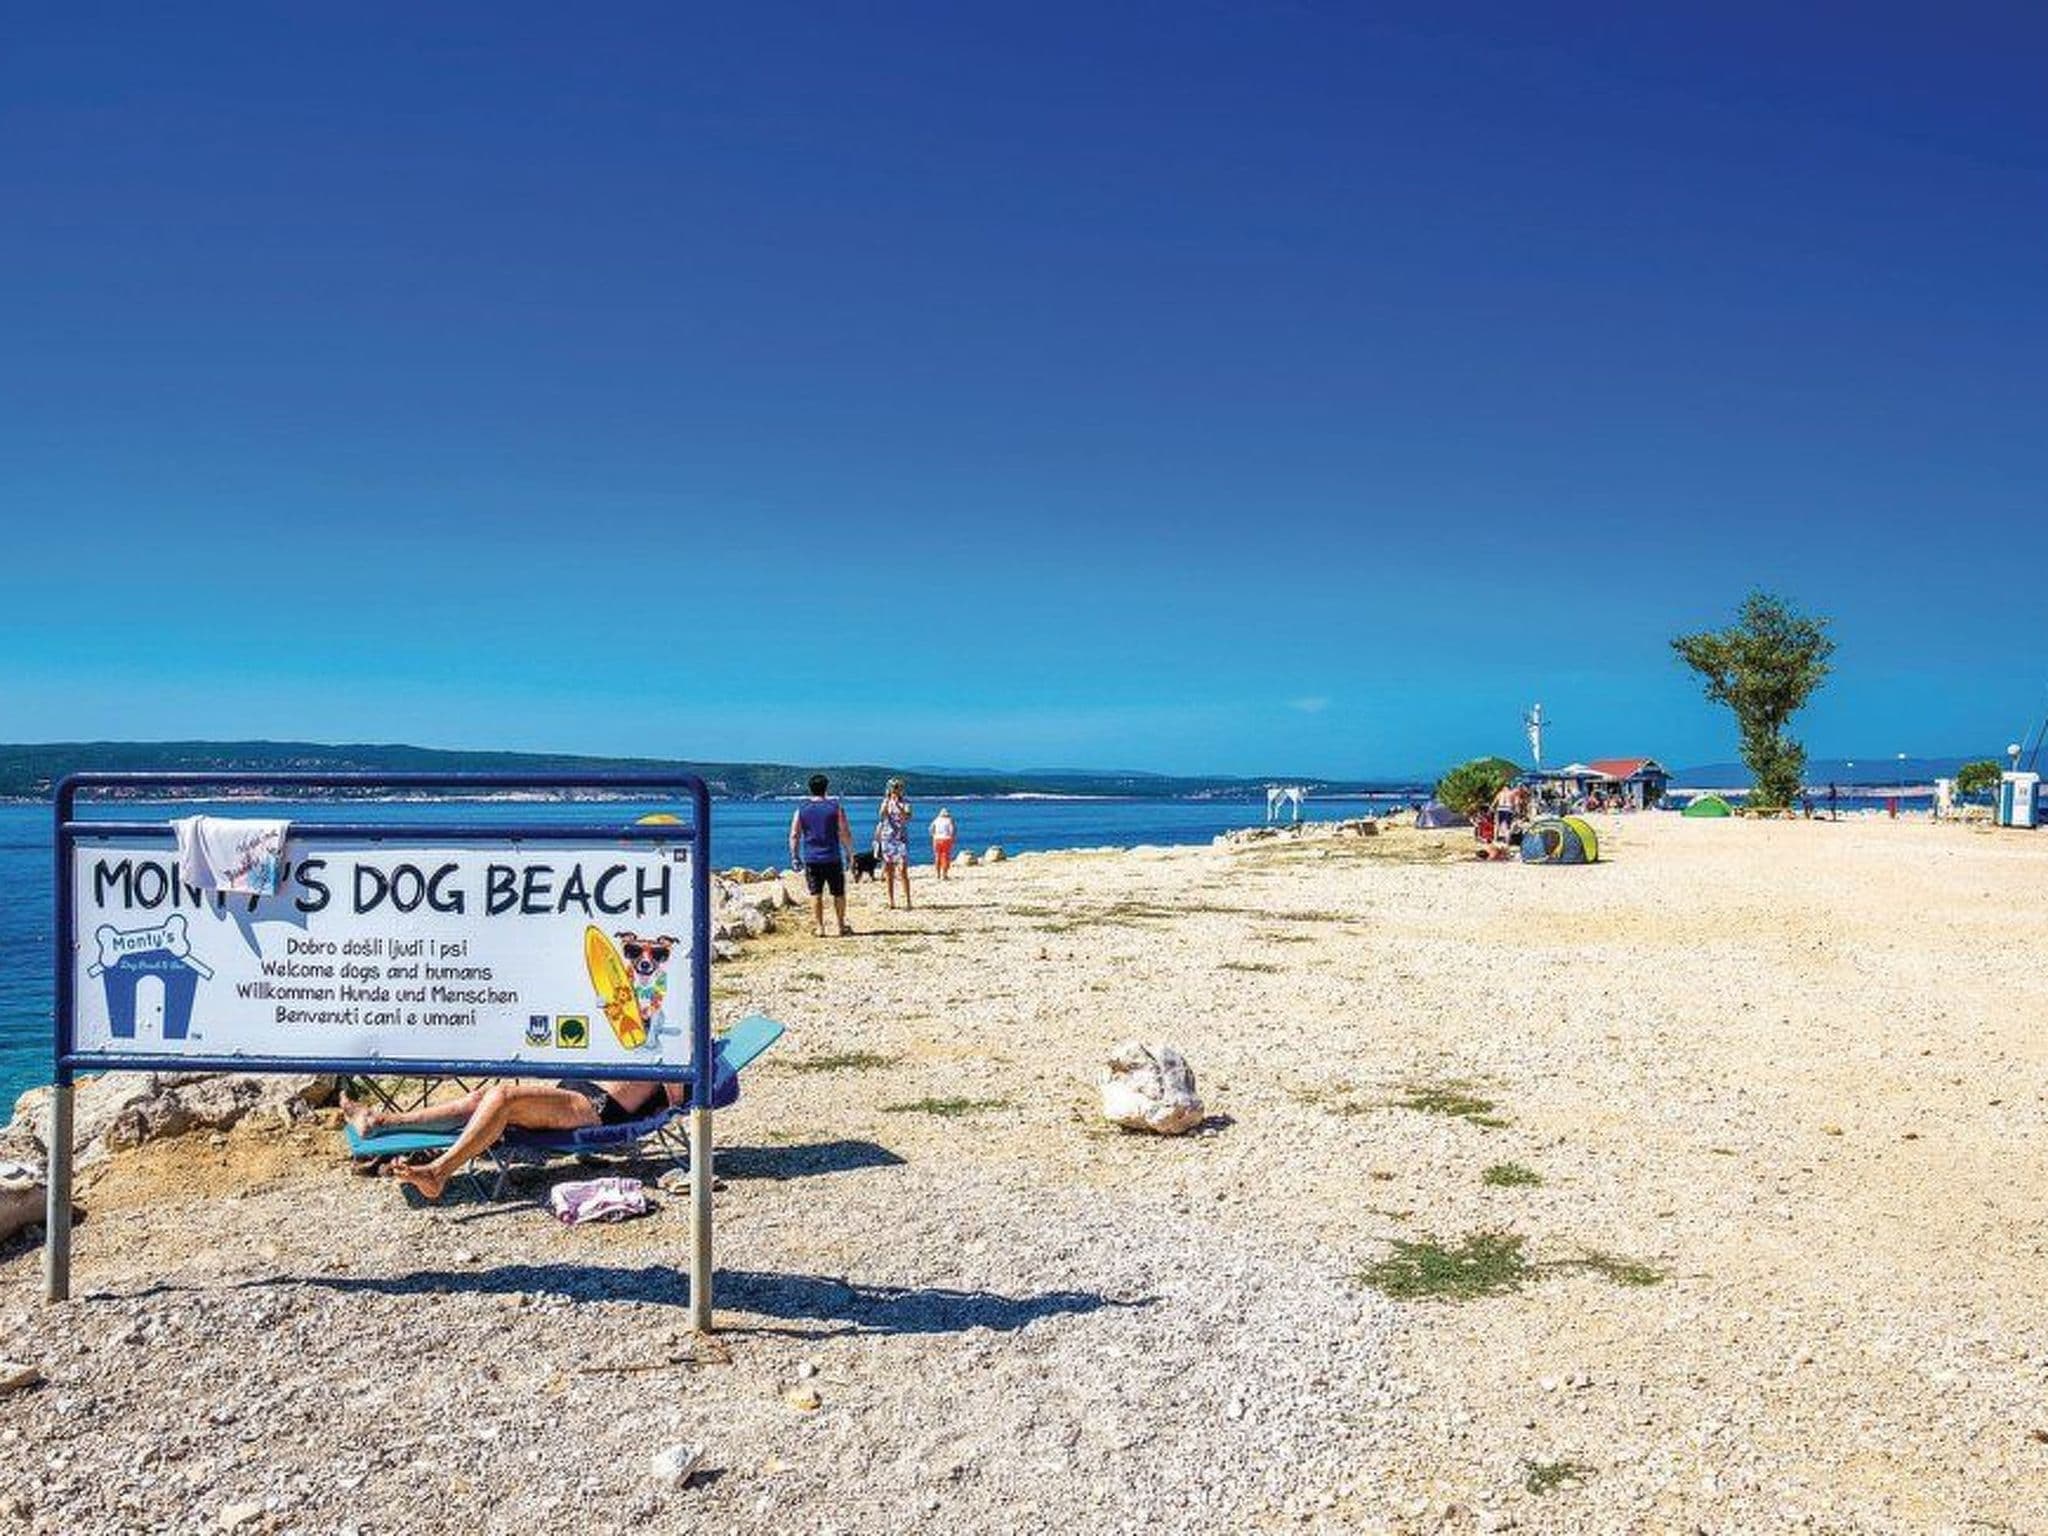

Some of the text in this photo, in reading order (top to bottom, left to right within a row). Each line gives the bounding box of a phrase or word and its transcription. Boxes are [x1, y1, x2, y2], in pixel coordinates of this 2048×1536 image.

[94, 857, 330, 912] MON'S
[354, 863, 465, 915] DOG
[485, 862, 672, 917] BEACH
[112, 931, 175, 950] Monty's
[287, 938, 337, 955] Dobro
[342, 938, 383, 956] došli
[388, 939, 423, 960] ljudi
[440, 940, 468, 960] psi
[261, 961, 493, 982] Welcome dogs and humans
[236, 983, 519, 1003] Willkommen Hunde und Menschen
[275, 1006, 476, 1026] Benvenuti cani e umani
